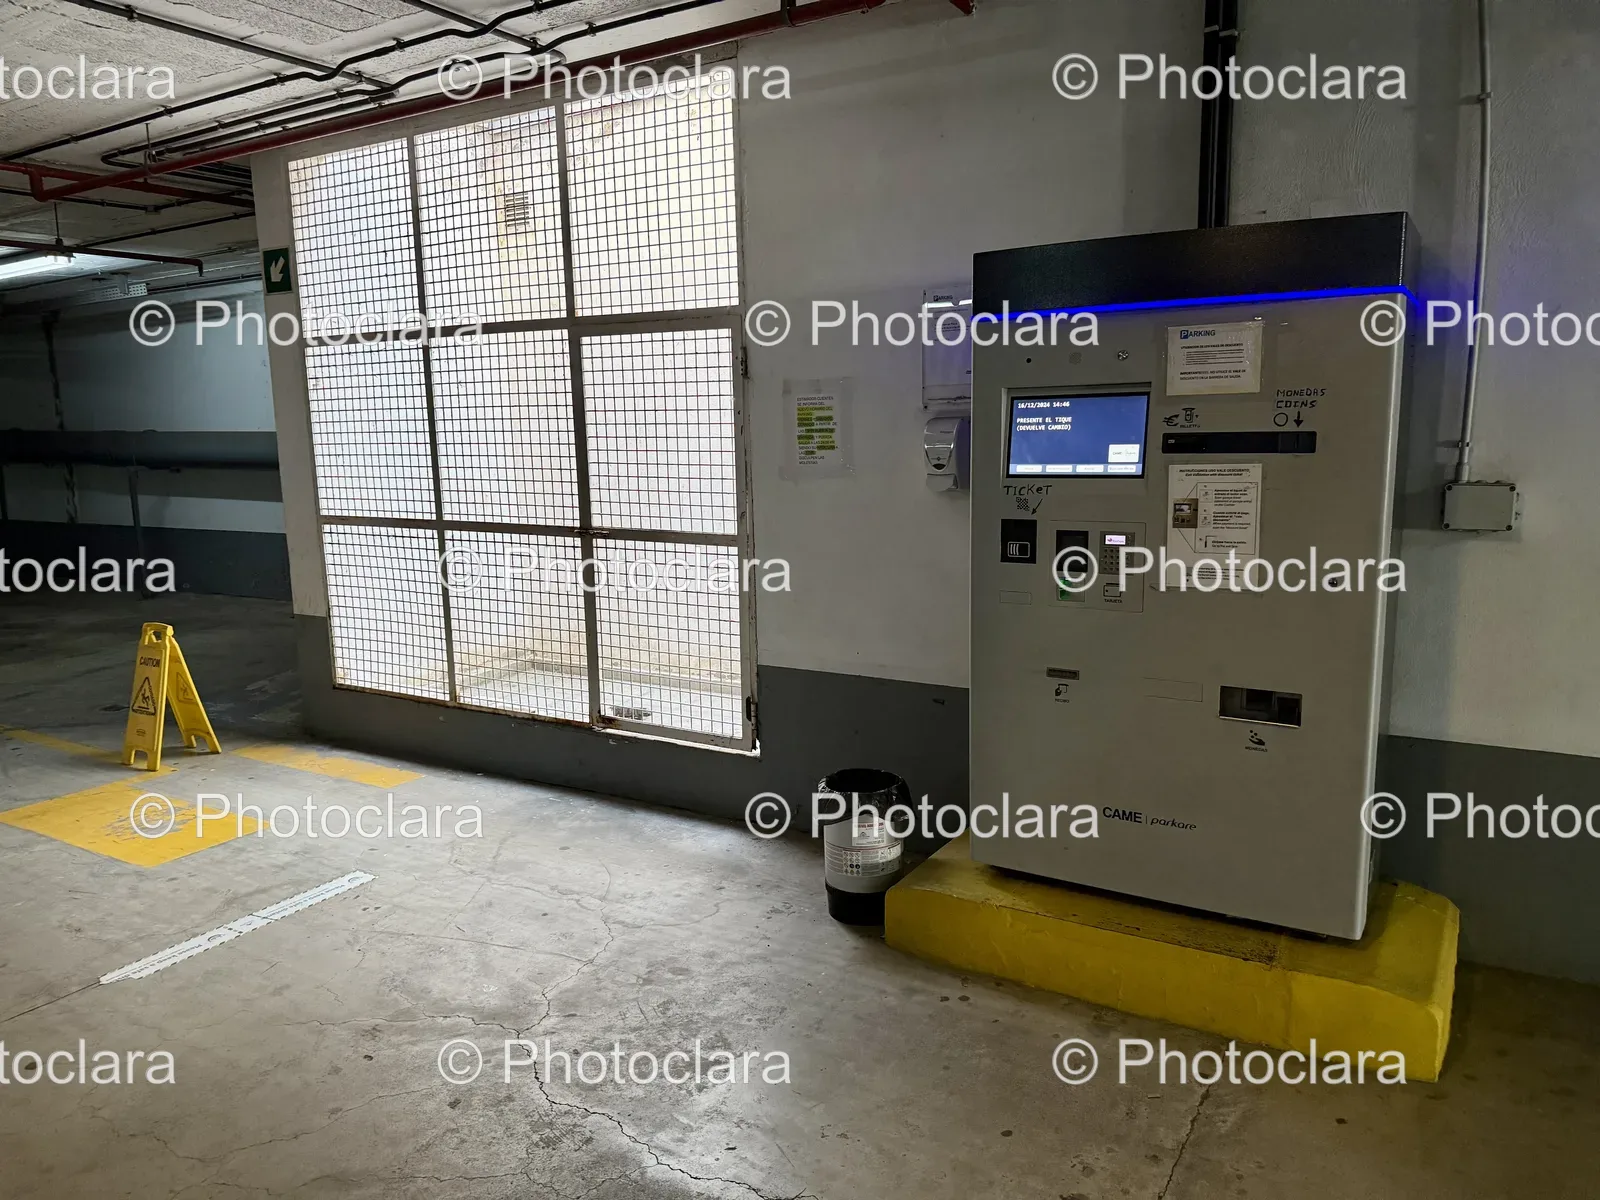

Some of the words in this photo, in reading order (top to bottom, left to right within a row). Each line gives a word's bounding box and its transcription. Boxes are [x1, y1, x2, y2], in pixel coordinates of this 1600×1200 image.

[1180, 330, 1215, 339] PARKING
[1277, 388, 1327, 397] MONEDAS
[1276, 400, 1317, 408] COINS
[140, 656, 160, 668] CAUTION
[1102, 806, 1142, 823] CAME
[1150, 817, 1197, 830] parkare
